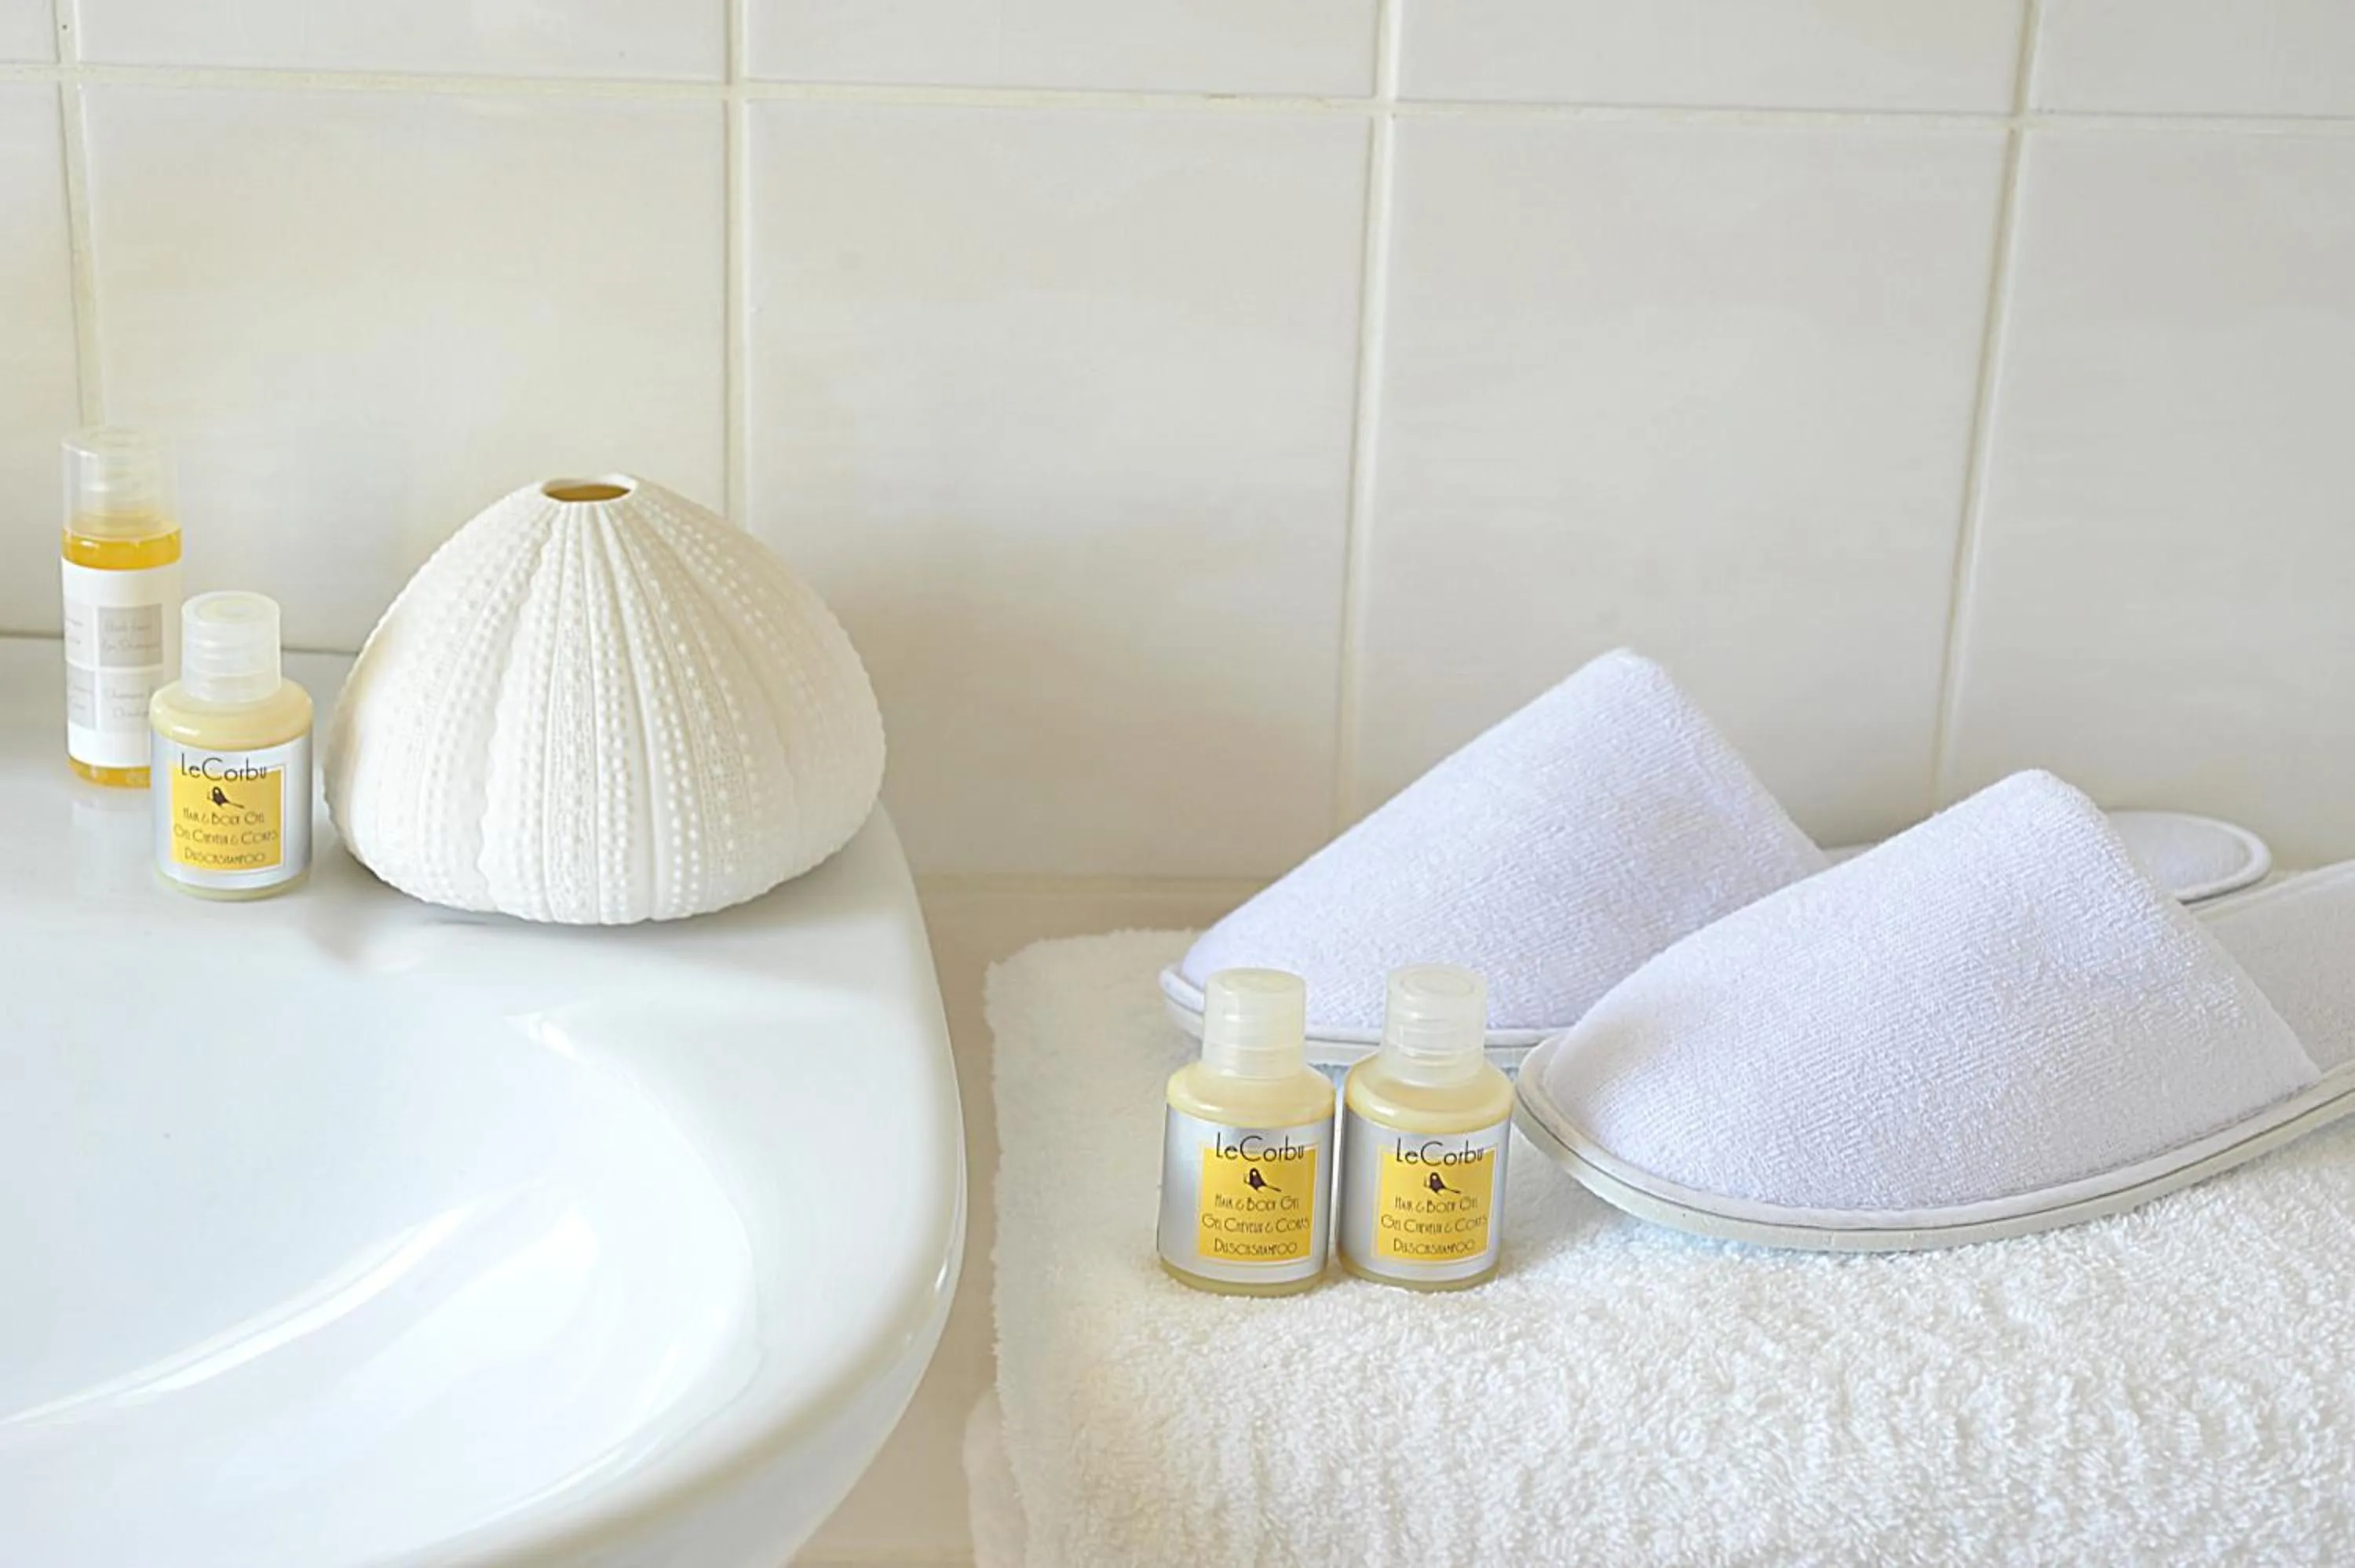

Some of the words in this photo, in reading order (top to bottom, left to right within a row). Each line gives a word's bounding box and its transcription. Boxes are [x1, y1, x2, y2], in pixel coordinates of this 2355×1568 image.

[181, 752, 267, 782] LeCorbu
[1215, 1132, 1304, 1162] LeCorbu
[1396, 1138, 1484, 1166] LeCorbu
